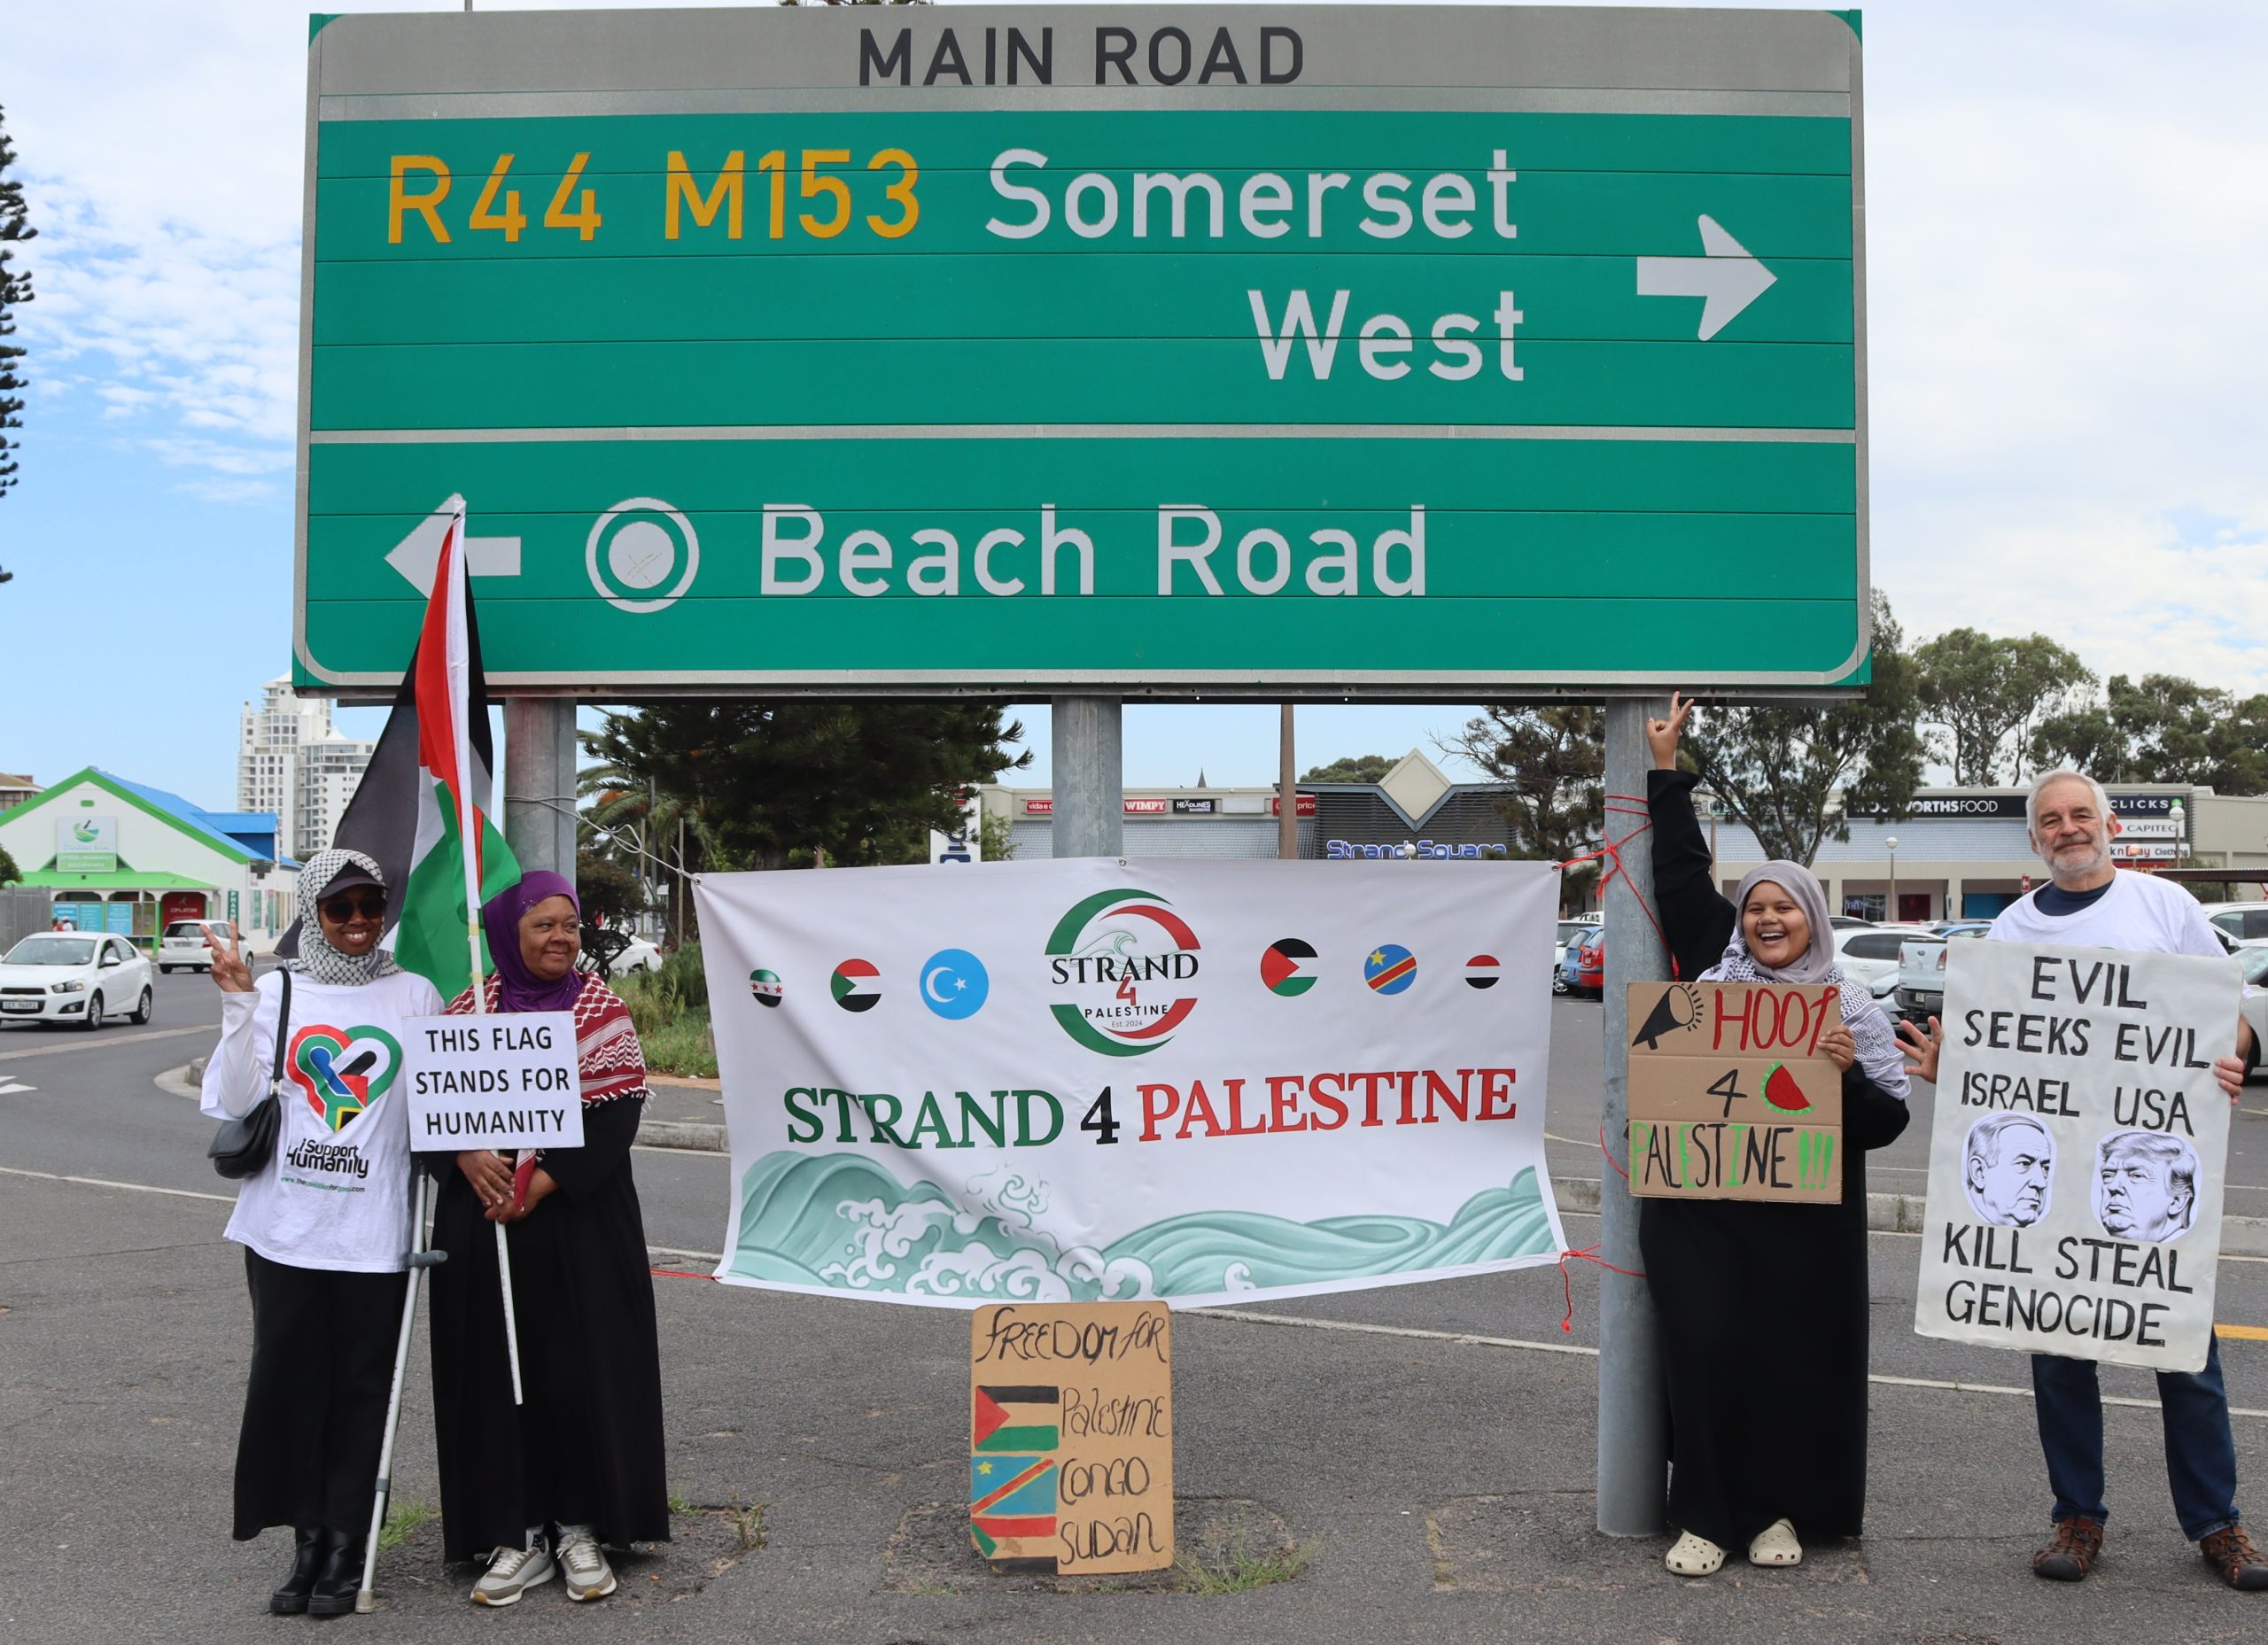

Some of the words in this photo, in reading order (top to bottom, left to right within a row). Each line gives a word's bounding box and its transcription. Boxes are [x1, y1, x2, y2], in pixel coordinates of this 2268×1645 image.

[859, 27, 1053, 86] MAIN
[1096, 27, 1304, 85] ROAD
[388, 153, 602, 244] R44
[664, 148, 920, 240] M153
[985, 148, 1518, 239] Somerset
[1247, 290, 1525, 382] West
[760, 503, 1095, 596] Beach
[1156, 504, 1426, 596] Road
[1125, 801, 1165, 811] WIMPY
[2109, 800, 2169, 809] CLICKS
[1327, 840, 1410, 859] Strand
[1052, 954, 1199, 985] STRAND
[1116, 975, 1137, 1006] 4
[2031, 956, 2147, 1010] EVIL
[1084, 1005, 1169, 1019] PALESTINE
[425, 1028, 480, 1052] THIS
[493, 1026, 552, 1051] FLAG
[1963, 1010, 2091, 1056] SEEKS
[2115, 1023, 2210, 1068] EVIL
[416, 1069, 509, 1094] STANDS
[522, 1067, 570, 1091] FOR
[1706, 1068, 1748, 1118] 4
[1961, 1071, 2080, 1117] ISRAEL
[2114, 1086, 2194, 1137] USA
[426, 1109, 564, 1135] HUMANITY
[784, 1087, 1064, 1149] STRAND
[1080, 1085, 1120, 1145] 4
[1137, 1068, 1517, 1142] PALESTINE
[1943, 1222, 2032, 1274] KILL
[2055, 1237, 2193, 1294] STEAL
[1946, 1280, 2170, 1347] GENOCIDE
